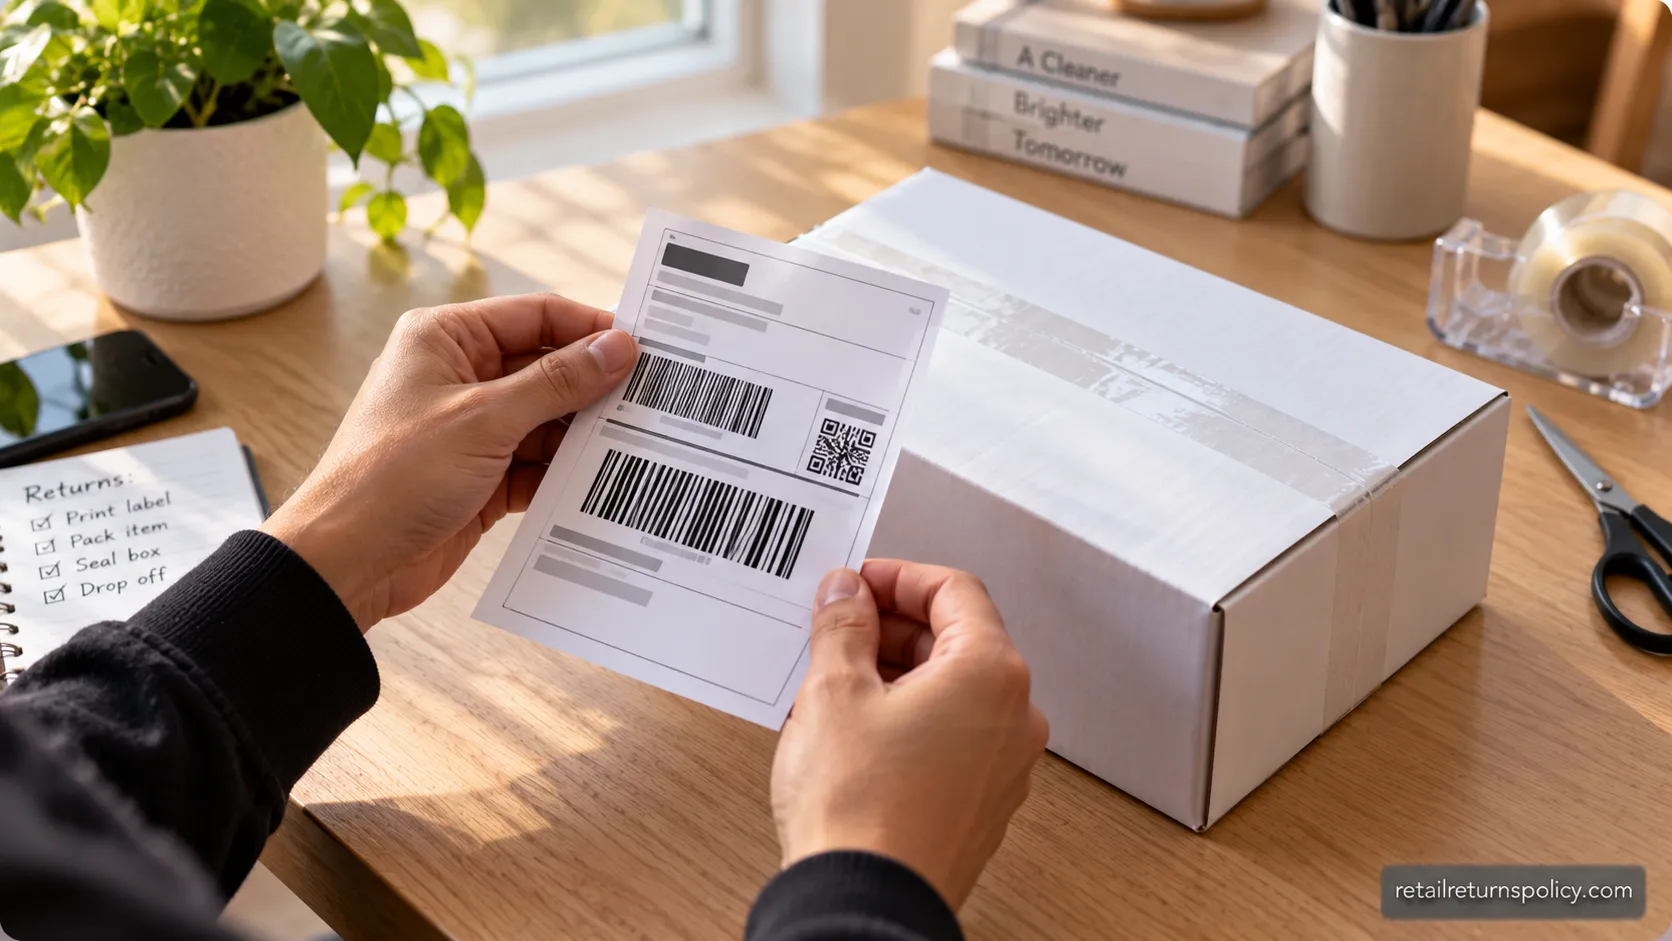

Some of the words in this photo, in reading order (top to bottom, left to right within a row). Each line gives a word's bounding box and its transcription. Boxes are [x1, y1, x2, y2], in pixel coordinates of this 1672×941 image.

[1017, 47, 1034, 66] A
[1041, 50, 1120, 86] Cleaner
[1015, 92, 1105, 134] Brighter
[1014, 131, 1127, 177] Tomorrow
[24, 473, 134, 504] Returns:
[66, 506, 116, 525] Print
[126, 491, 171, 513] label
[70, 529, 116, 549] Pack
[126, 520, 168, 538] item
[76, 552, 116, 573] Seal
[128, 545, 161, 562] box
[80, 579, 128, 597] Drop
[138, 566, 167, 585] off
